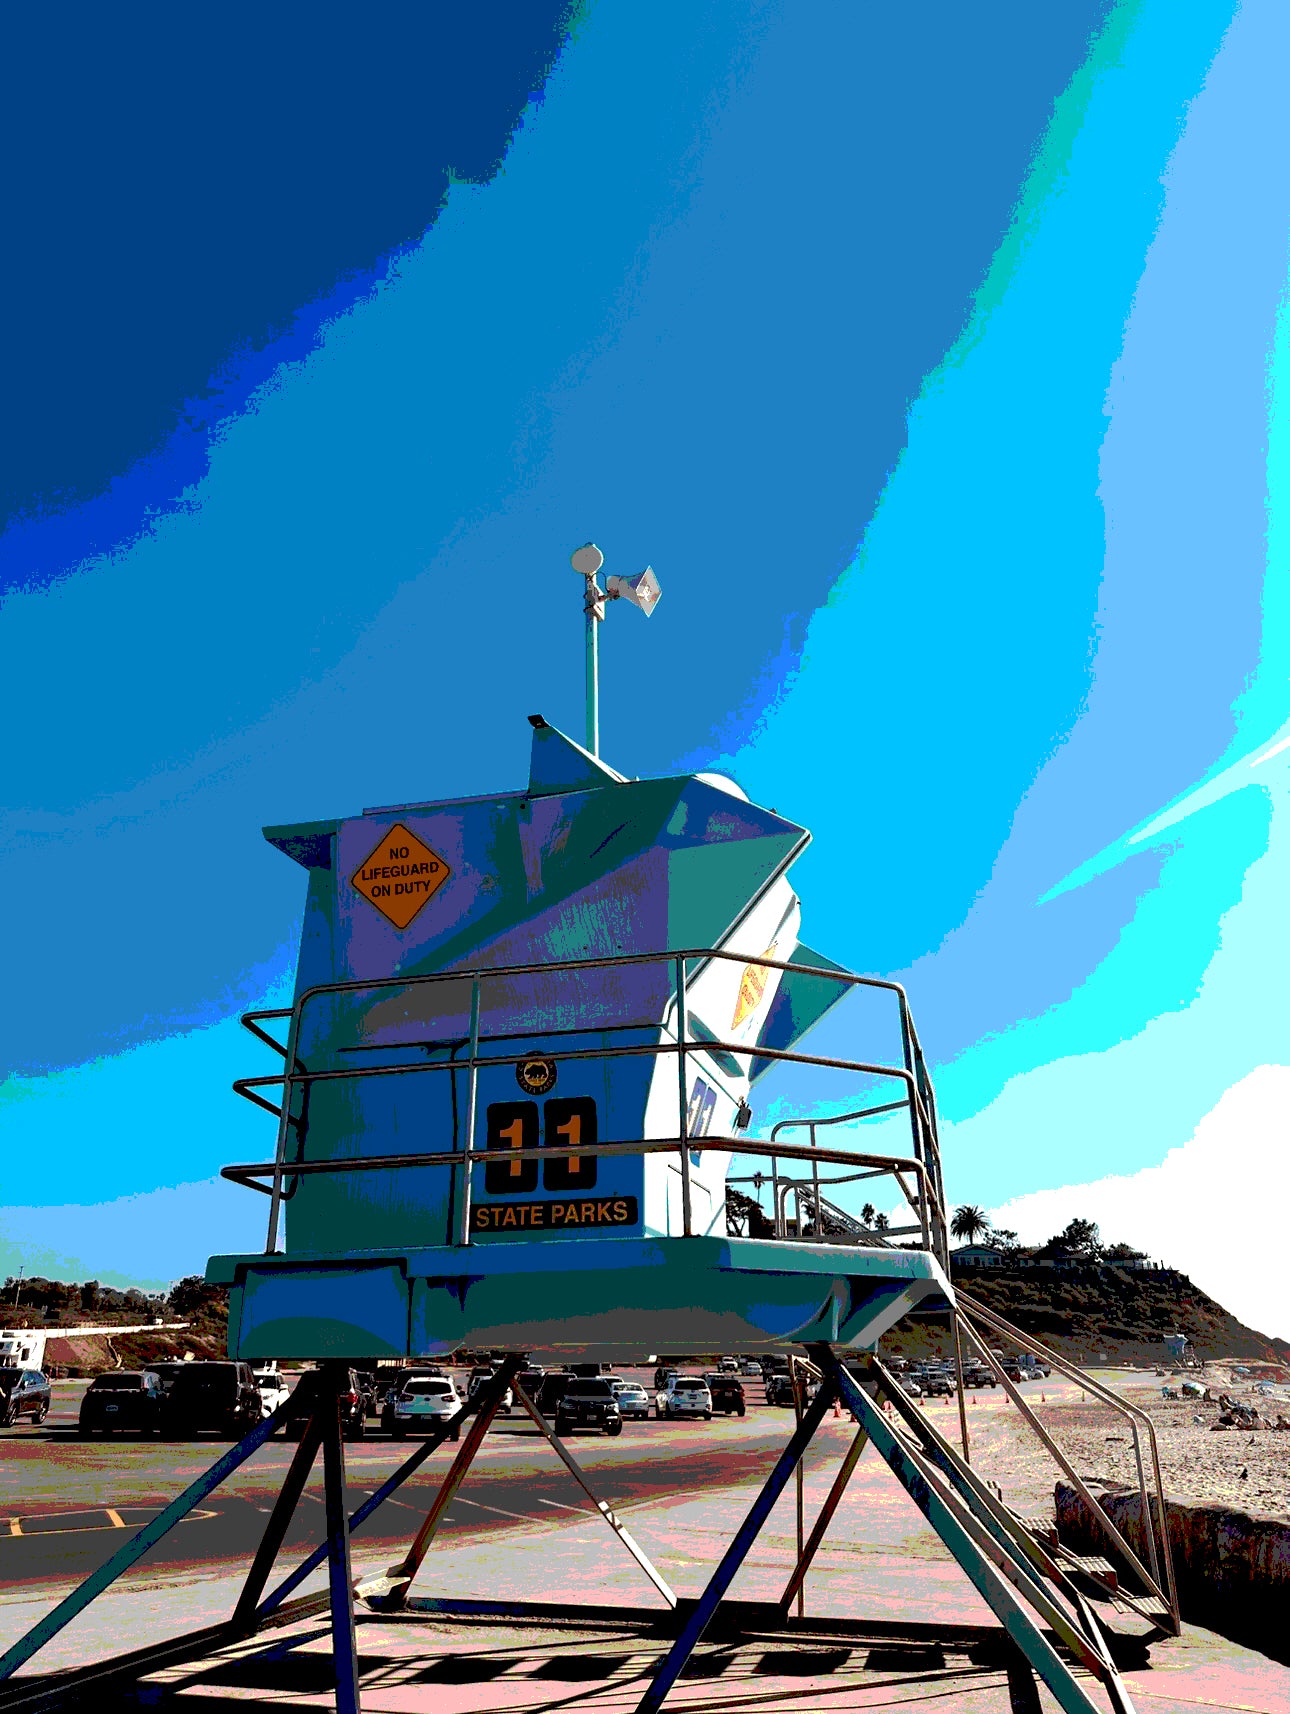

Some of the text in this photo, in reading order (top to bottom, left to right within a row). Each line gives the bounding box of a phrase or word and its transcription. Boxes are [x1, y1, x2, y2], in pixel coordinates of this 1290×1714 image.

[390, 847, 409, 860] NO
[362, 862, 439, 880] LIFEGUARD
[371, 880, 430, 897] ON DUTY
[476, 1201, 627, 1227] STATE PARKS
